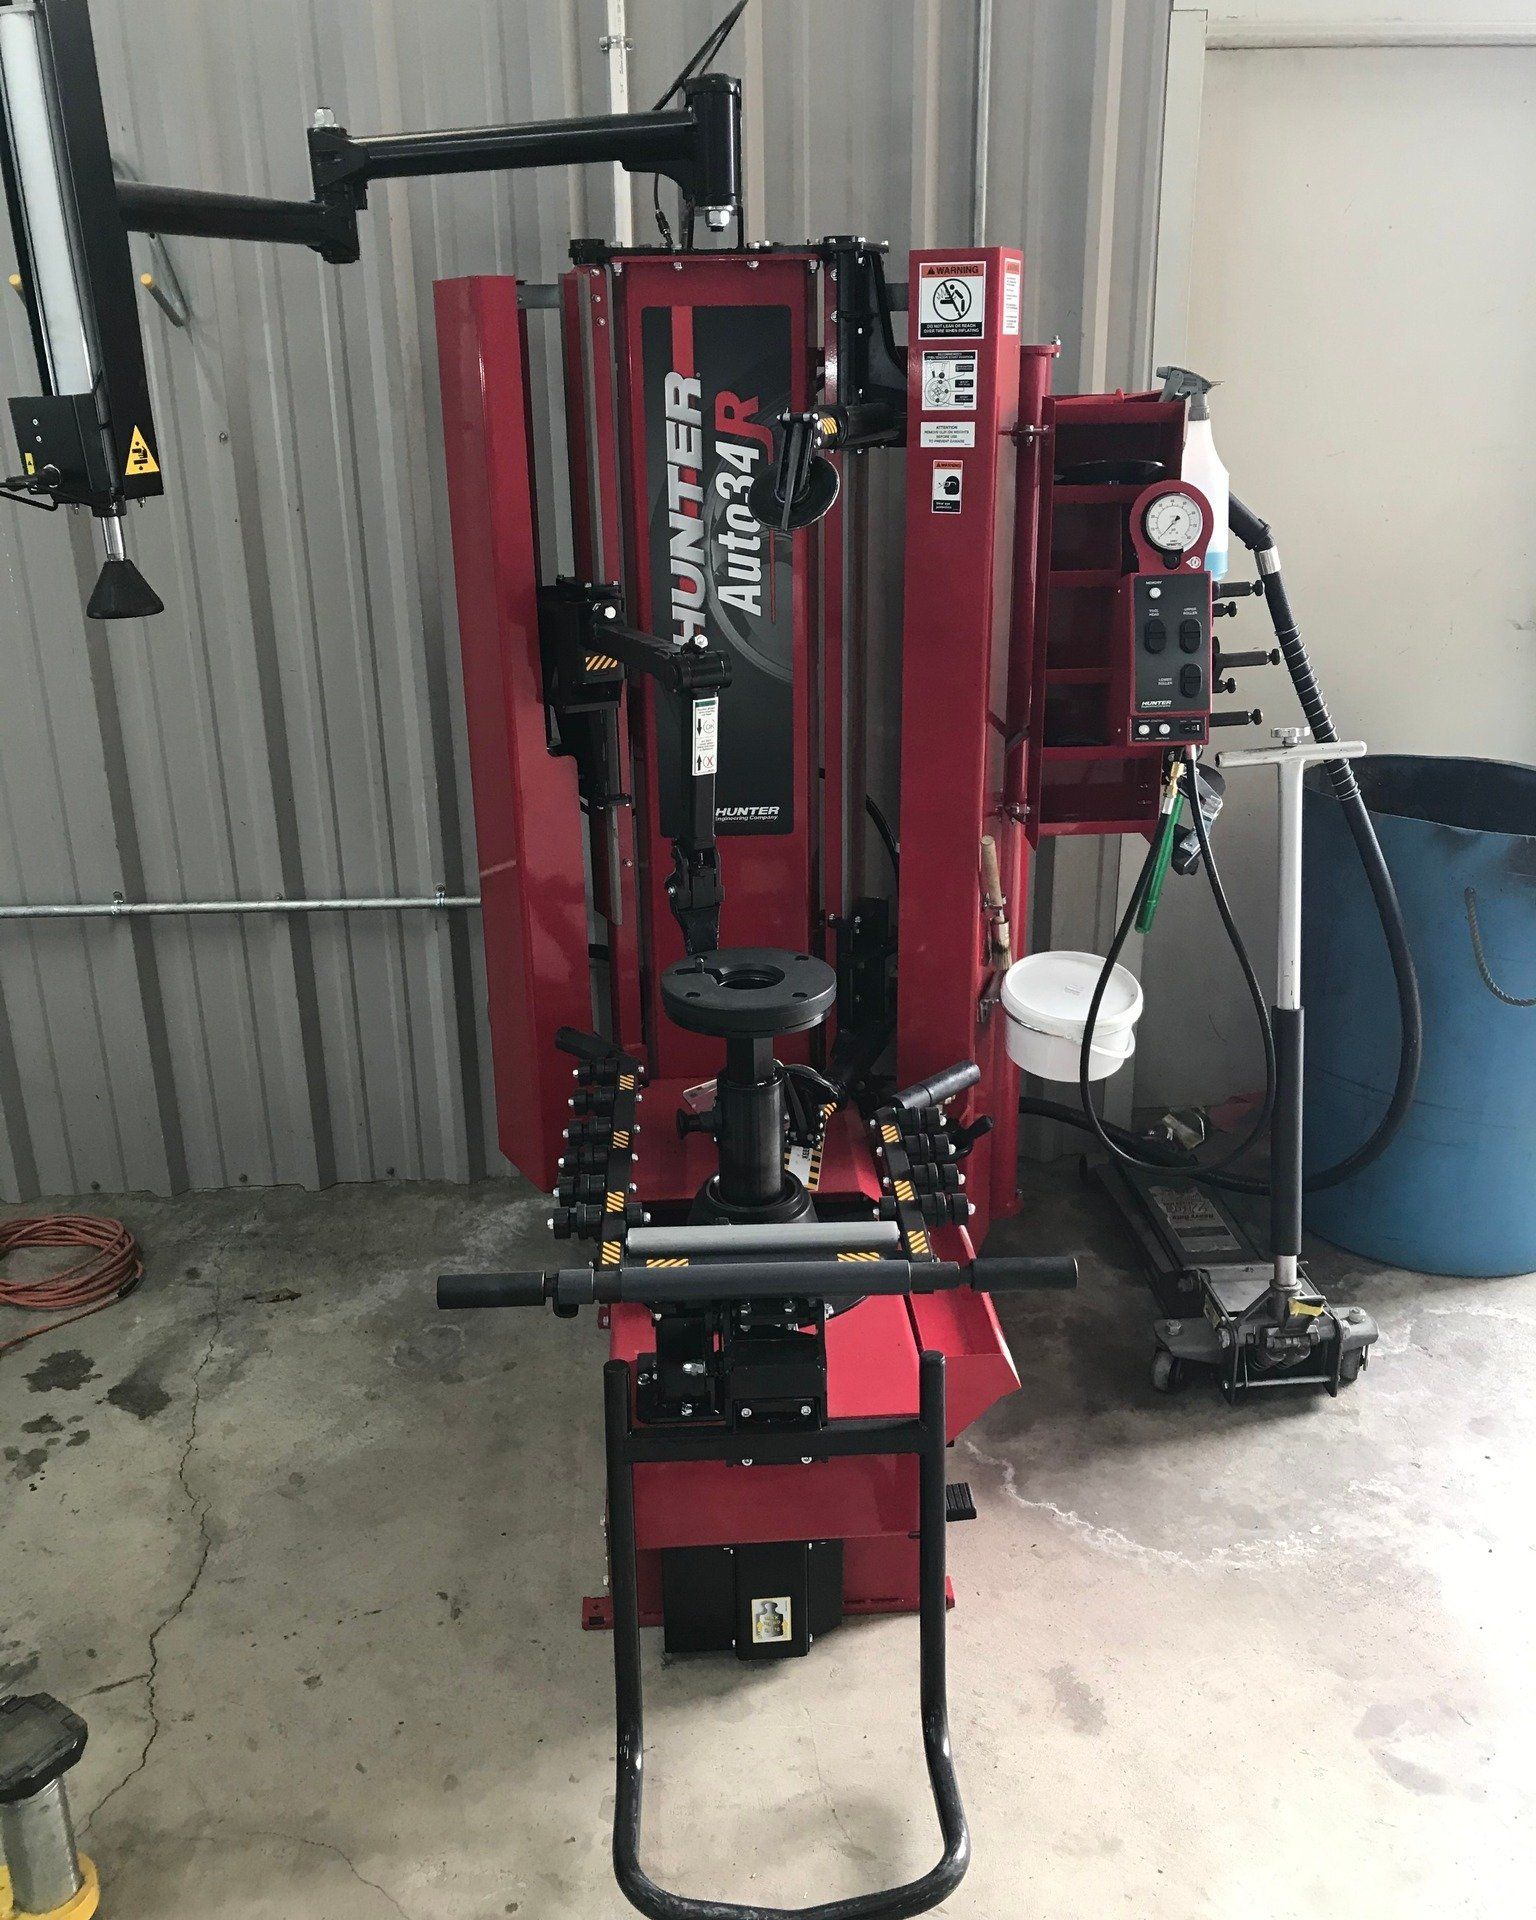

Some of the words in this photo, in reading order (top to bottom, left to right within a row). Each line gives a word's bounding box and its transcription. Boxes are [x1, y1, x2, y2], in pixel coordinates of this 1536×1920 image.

[936, 266, 979, 275] WARNING
[664, 371, 707, 646] HUNTER
[715, 806, 780, 817] HUNTER
